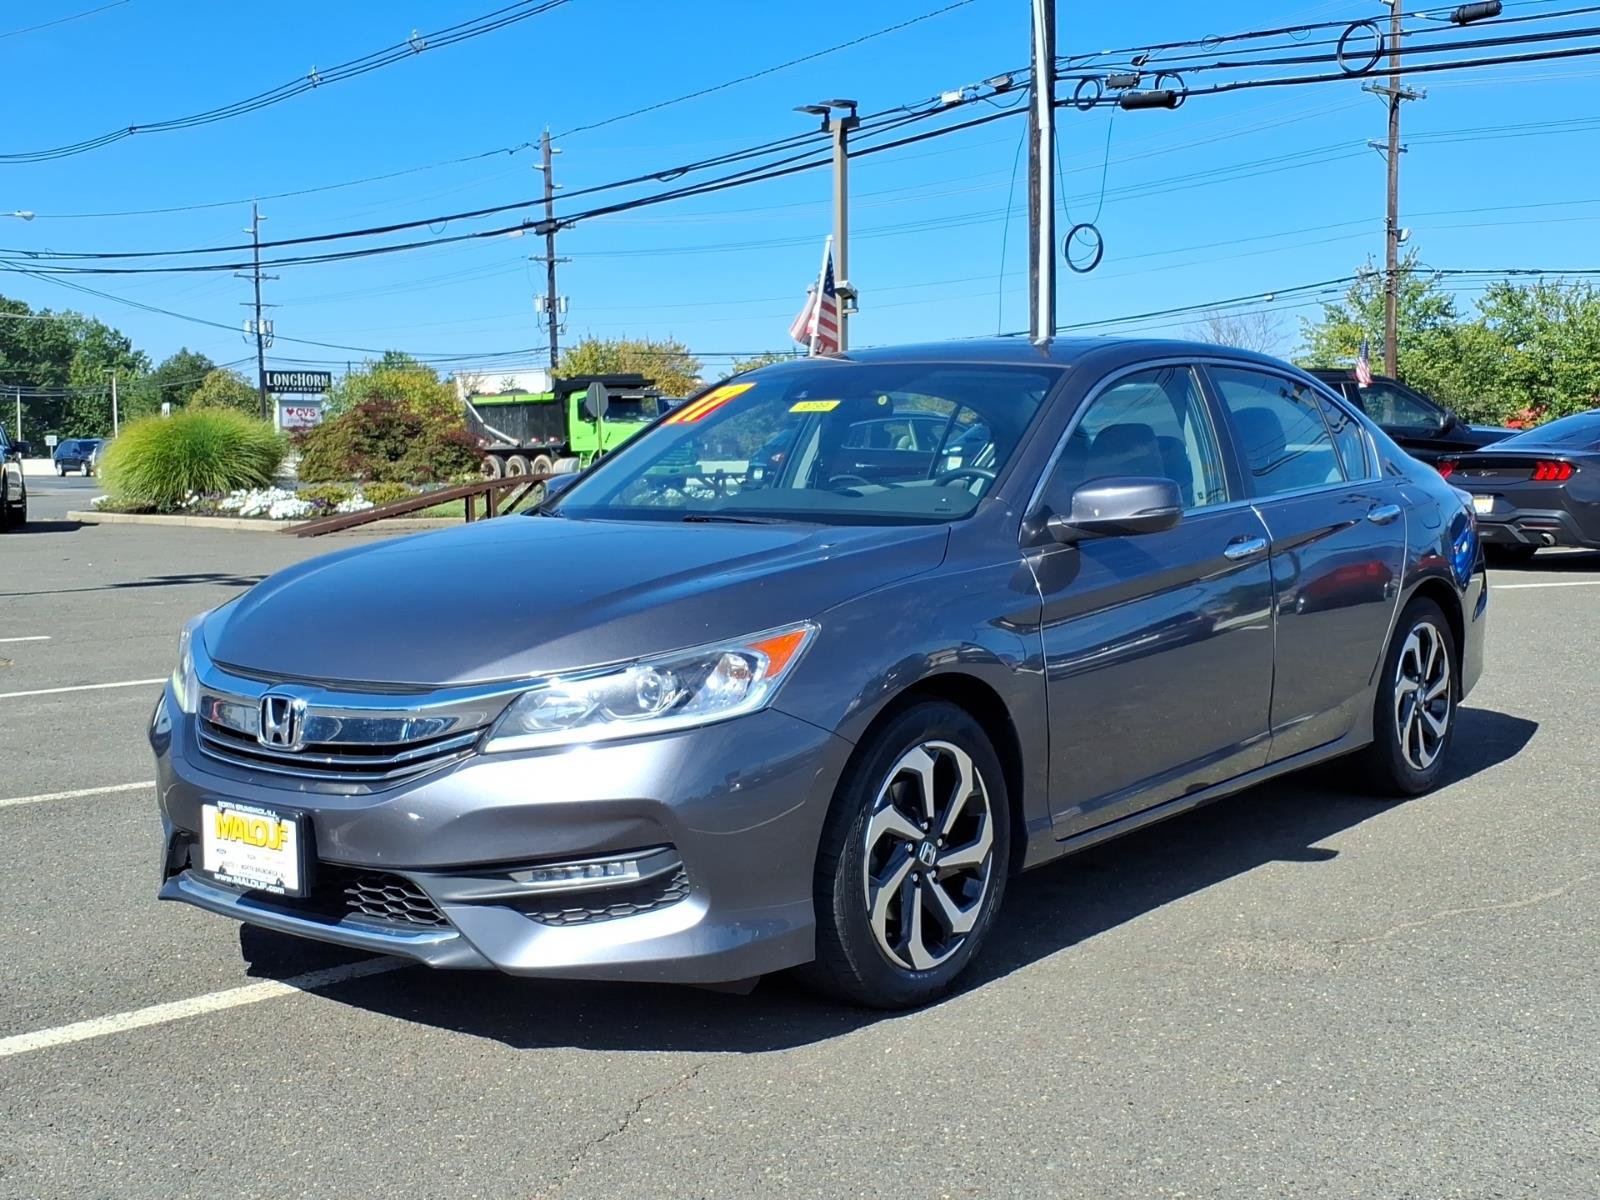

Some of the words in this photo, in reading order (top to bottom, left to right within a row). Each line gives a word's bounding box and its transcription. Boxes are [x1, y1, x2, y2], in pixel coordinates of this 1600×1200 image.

[266, 373, 329, 387] LONGHORN
[296, 407, 316, 417] CVS
[215, 812, 288, 851] MALOUF
[214, 872, 285, 895] www.MALOUF.com
